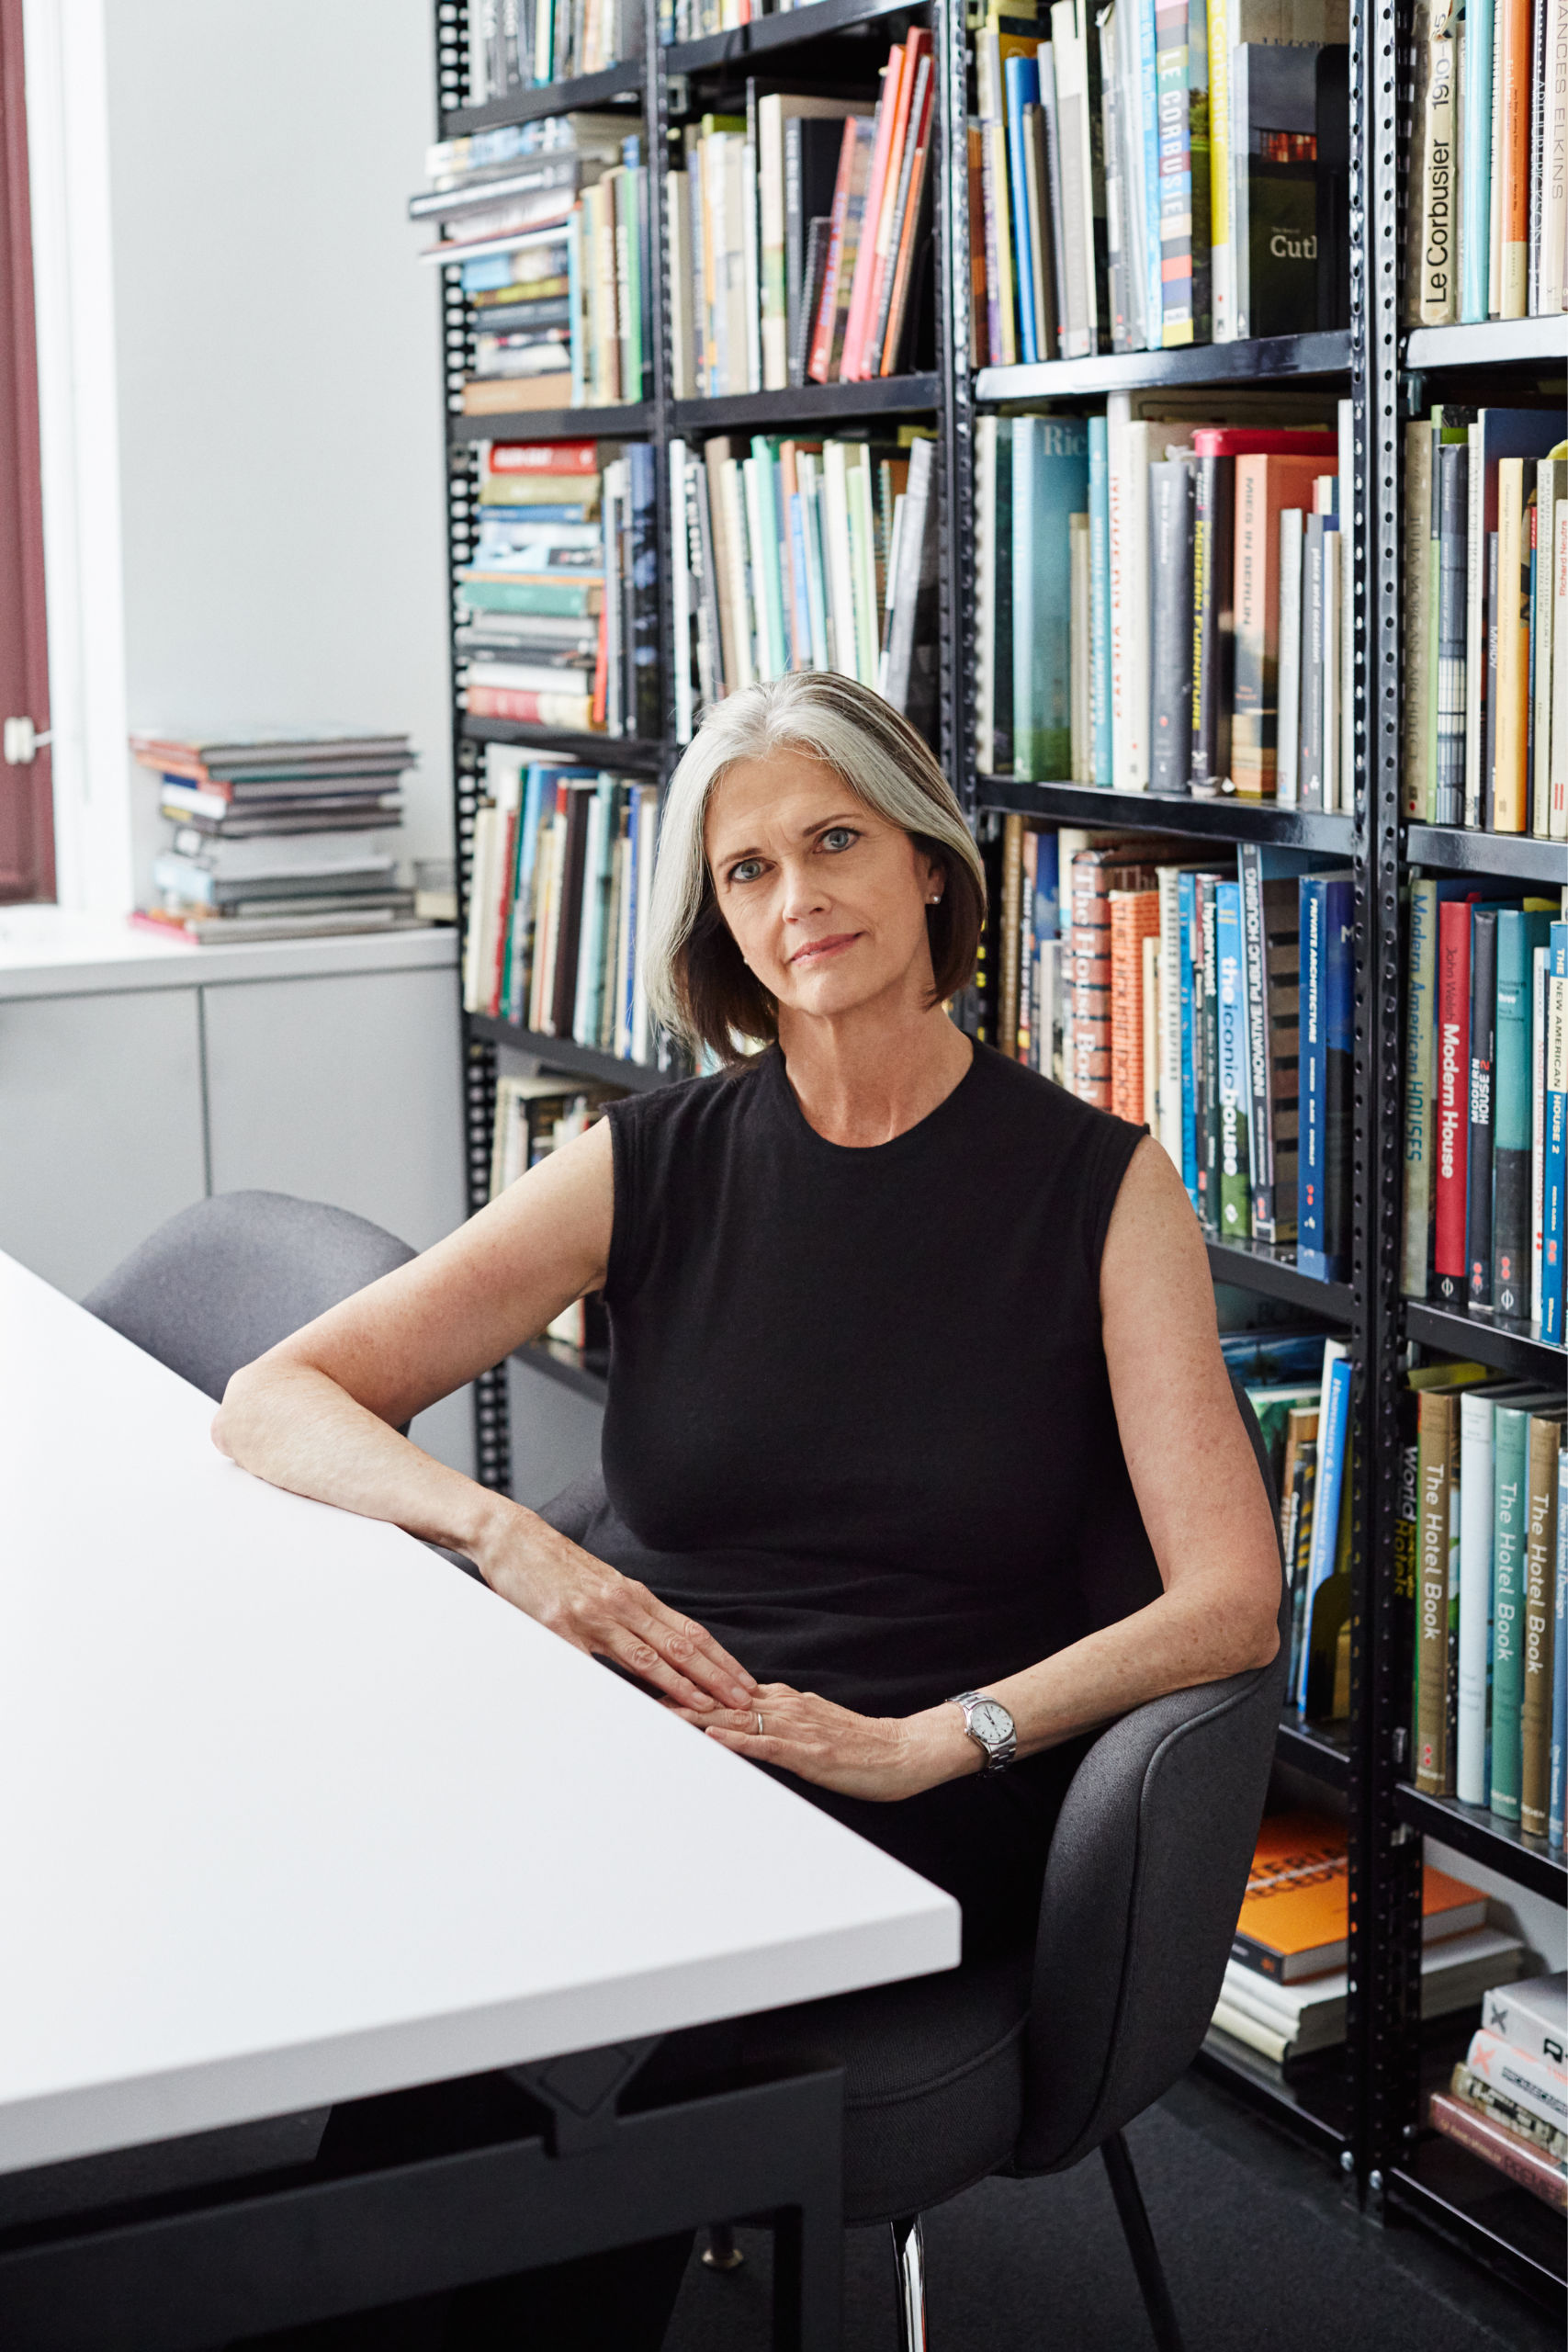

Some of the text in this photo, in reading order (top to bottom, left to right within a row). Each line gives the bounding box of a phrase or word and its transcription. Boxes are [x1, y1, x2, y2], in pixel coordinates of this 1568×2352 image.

[1551, 1, 1568, 199] ANCES ELKINS
[1160, 51, 1185, 232] LE CORBUSIER
[1427, 139, 1450, 266] Corbusier
[1425, 272, 1448, 303] Le
[1311, 548, 1322, 582] place
[1312, 583, 1322, 607] and
[1559, 558, 1568, 596] Richard
[1489, 625, 1498, 670] MVRDV
[1075, 865, 1096, 926] The
[1244, 867, 1261, 943] HOUSING
[1309, 898, 1319, 949] PRIVATE
[1075, 932, 1096, 1025] House
[1247, 943, 1264, 1002] PUBLIC
[1308, 949, 1318, 1045] ARCHITECTURE
[1445, 947, 1459, 978] John
[1250, 1003, 1266, 1098] INNOVATIVE
[1405, 893, 1428, 1163] Modern American HOUSES
[1551, 947, 1565, 1154] THE NEW AMERICAN HOUSE 2
[1440, 1023, 1461, 1179] Modern House
[1471, 1057, 1480, 1124] MODERN
[1478, 1059, 1490, 1125] HOUSE 2
[1402, 1446, 1418, 1522] World
[1423, 1464, 1445, 1640] The Hotel Book
[1496, 1482, 1518, 1662] The Hotel Book
[1527, 1493, 1550, 1675] The Hotel Book
